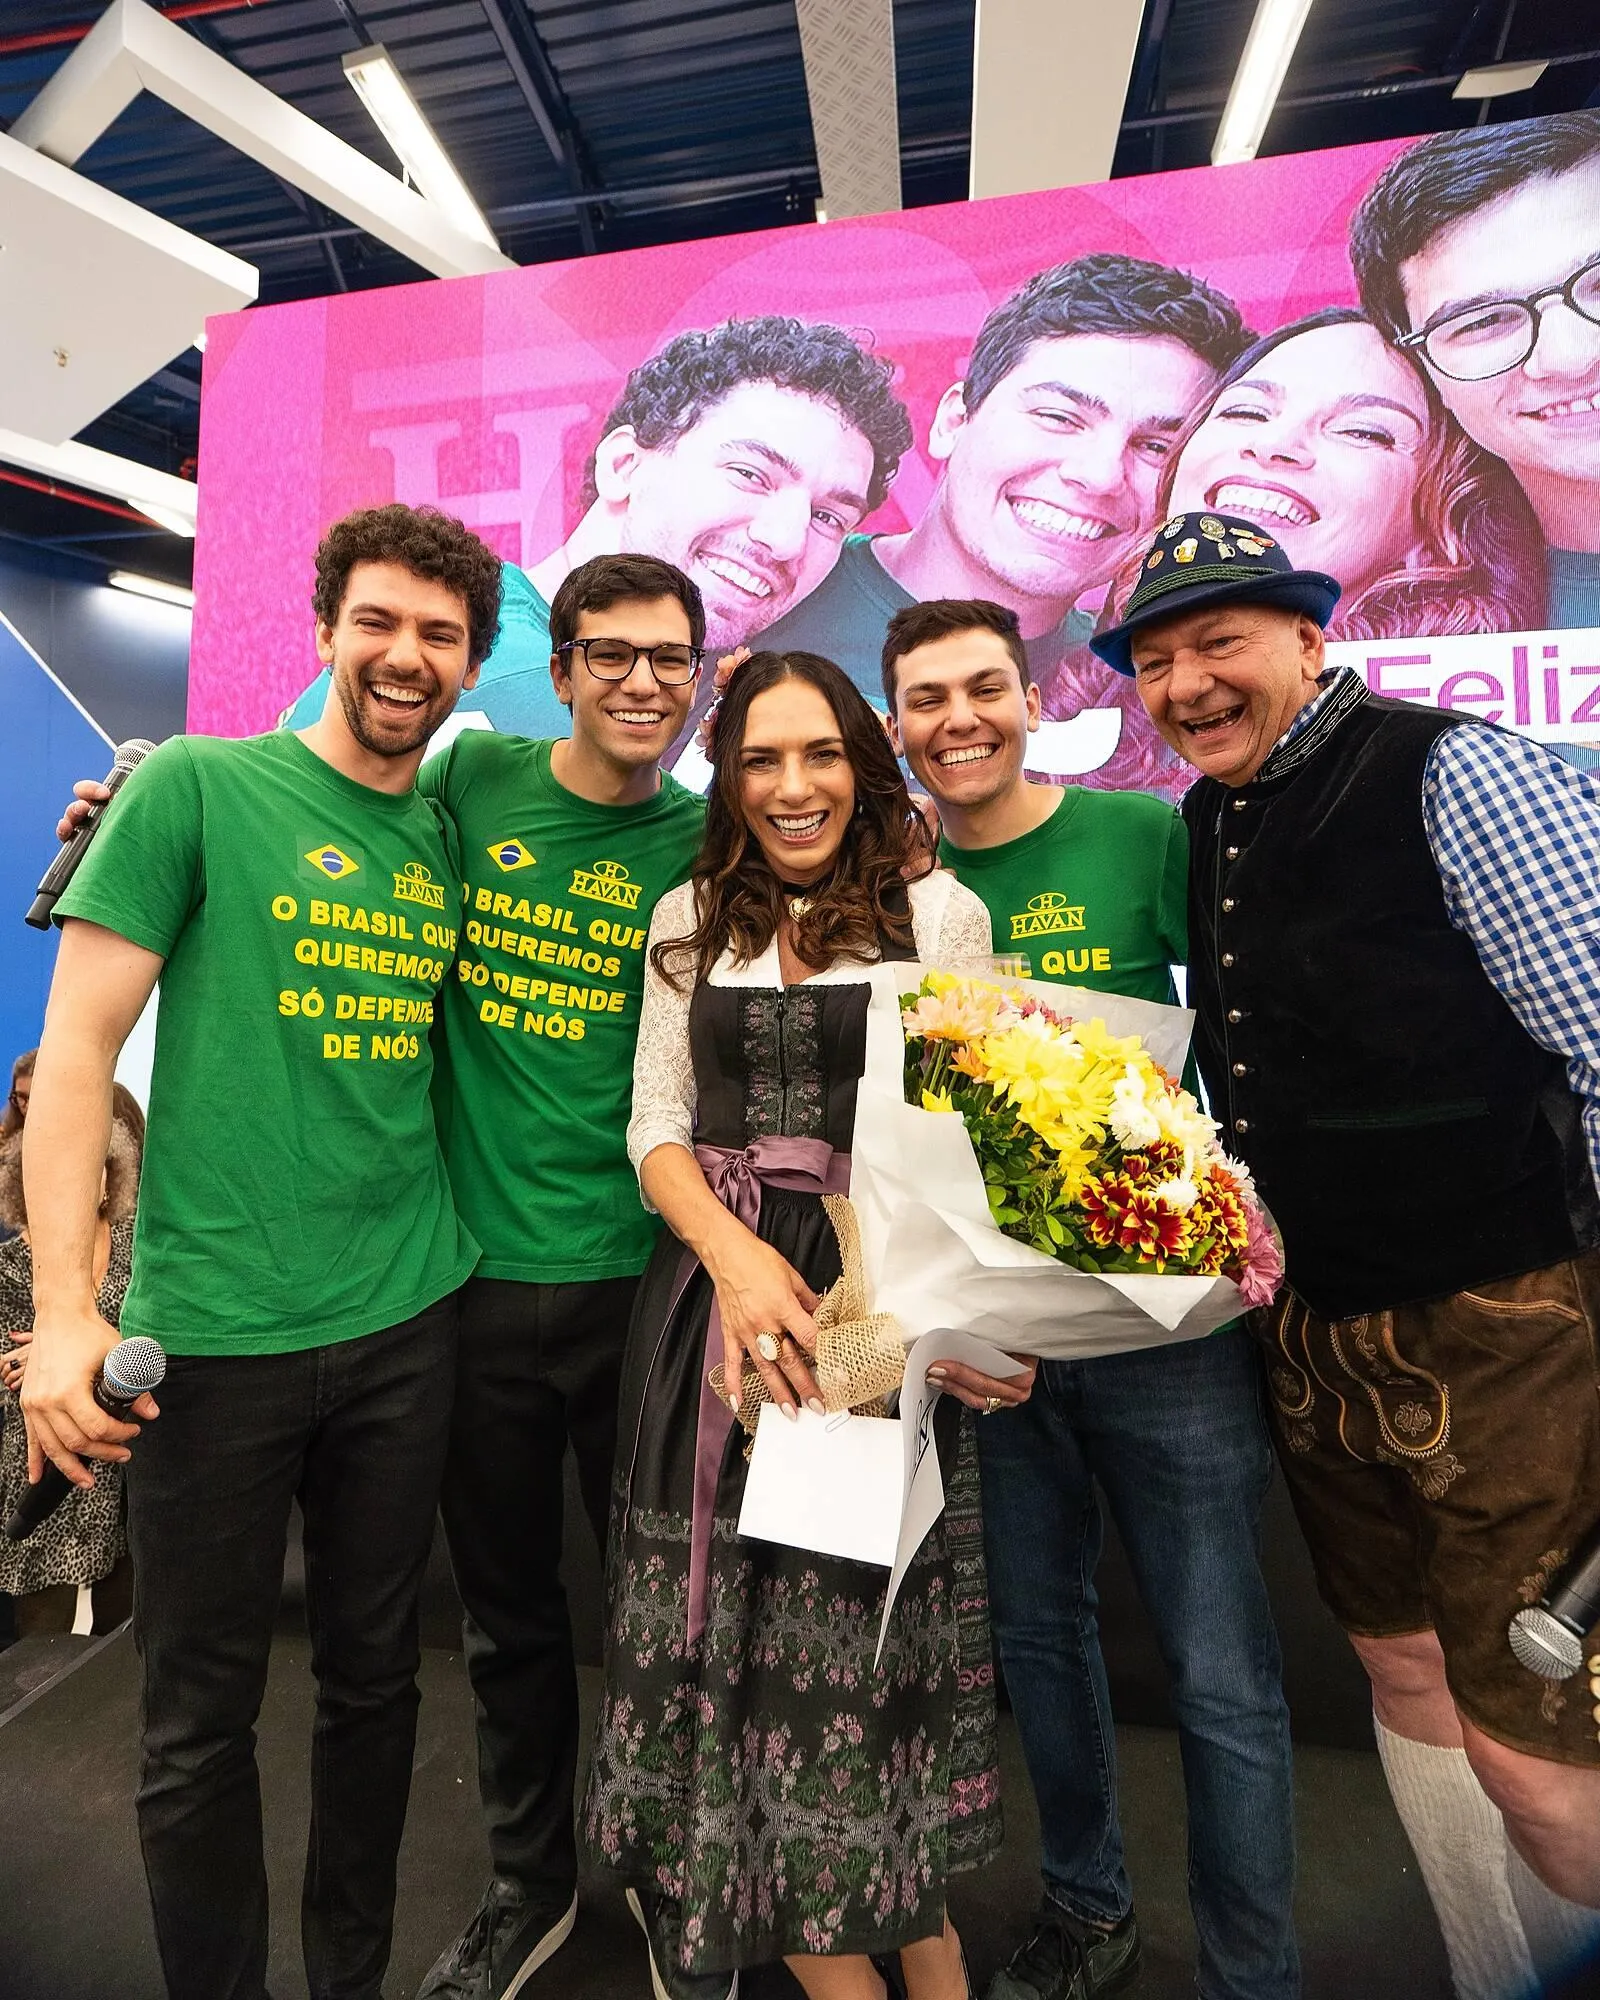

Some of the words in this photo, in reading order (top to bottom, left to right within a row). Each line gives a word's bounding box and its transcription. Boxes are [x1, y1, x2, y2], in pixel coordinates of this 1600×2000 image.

[394, 878, 444, 905] HAVAN
[570, 874, 641, 905] HAVAN
[272, 895, 298, 921] O
[310, 900, 414, 941] BRASIL
[422, 922, 457, 952] QUE
[475, 888, 579, 935] BRASIL
[588, 920, 647, 950] QUE
[1011, 910, 1084, 935] HAVAN
[295, 938, 444, 983] QUEREMOS
[466, 920, 621, 977] QUEREMOS
[1041, 948, 1112, 976] QUE
[279, 987, 325, 1018] SÓ
[336, 995, 434, 1023] DEPENDE
[458, 959, 490, 987] SÓ
[493, 972, 626, 1013] DEPENDE
[479, 1000, 518, 1029] DE
[523, 1010, 586, 1041] NÓS
[323, 1034, 361, 1060] DE
[371, 1030, 419, 1060] NÓS
